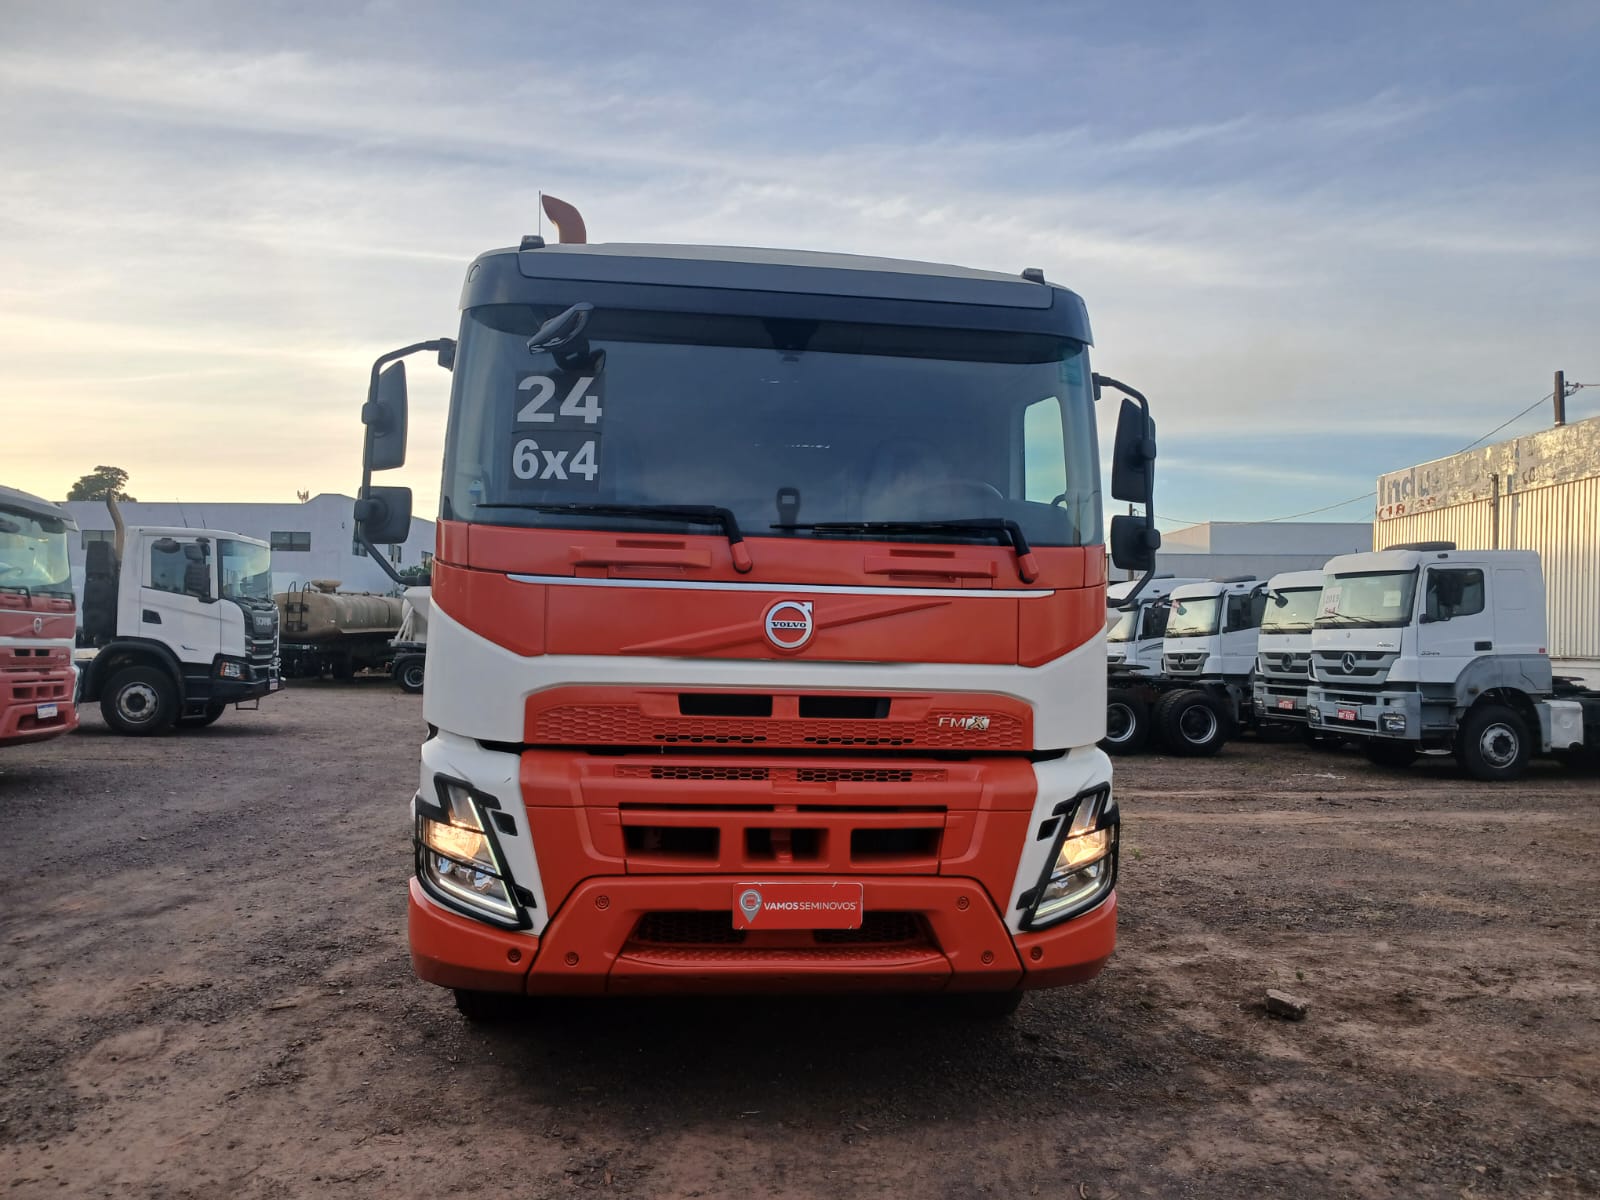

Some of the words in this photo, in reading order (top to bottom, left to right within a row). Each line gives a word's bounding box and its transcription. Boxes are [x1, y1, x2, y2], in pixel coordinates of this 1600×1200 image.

[517, 375, 602, 424] 24
[512, 438, 599, 481] 6x4
[938, 715, 988, 731] FMX
